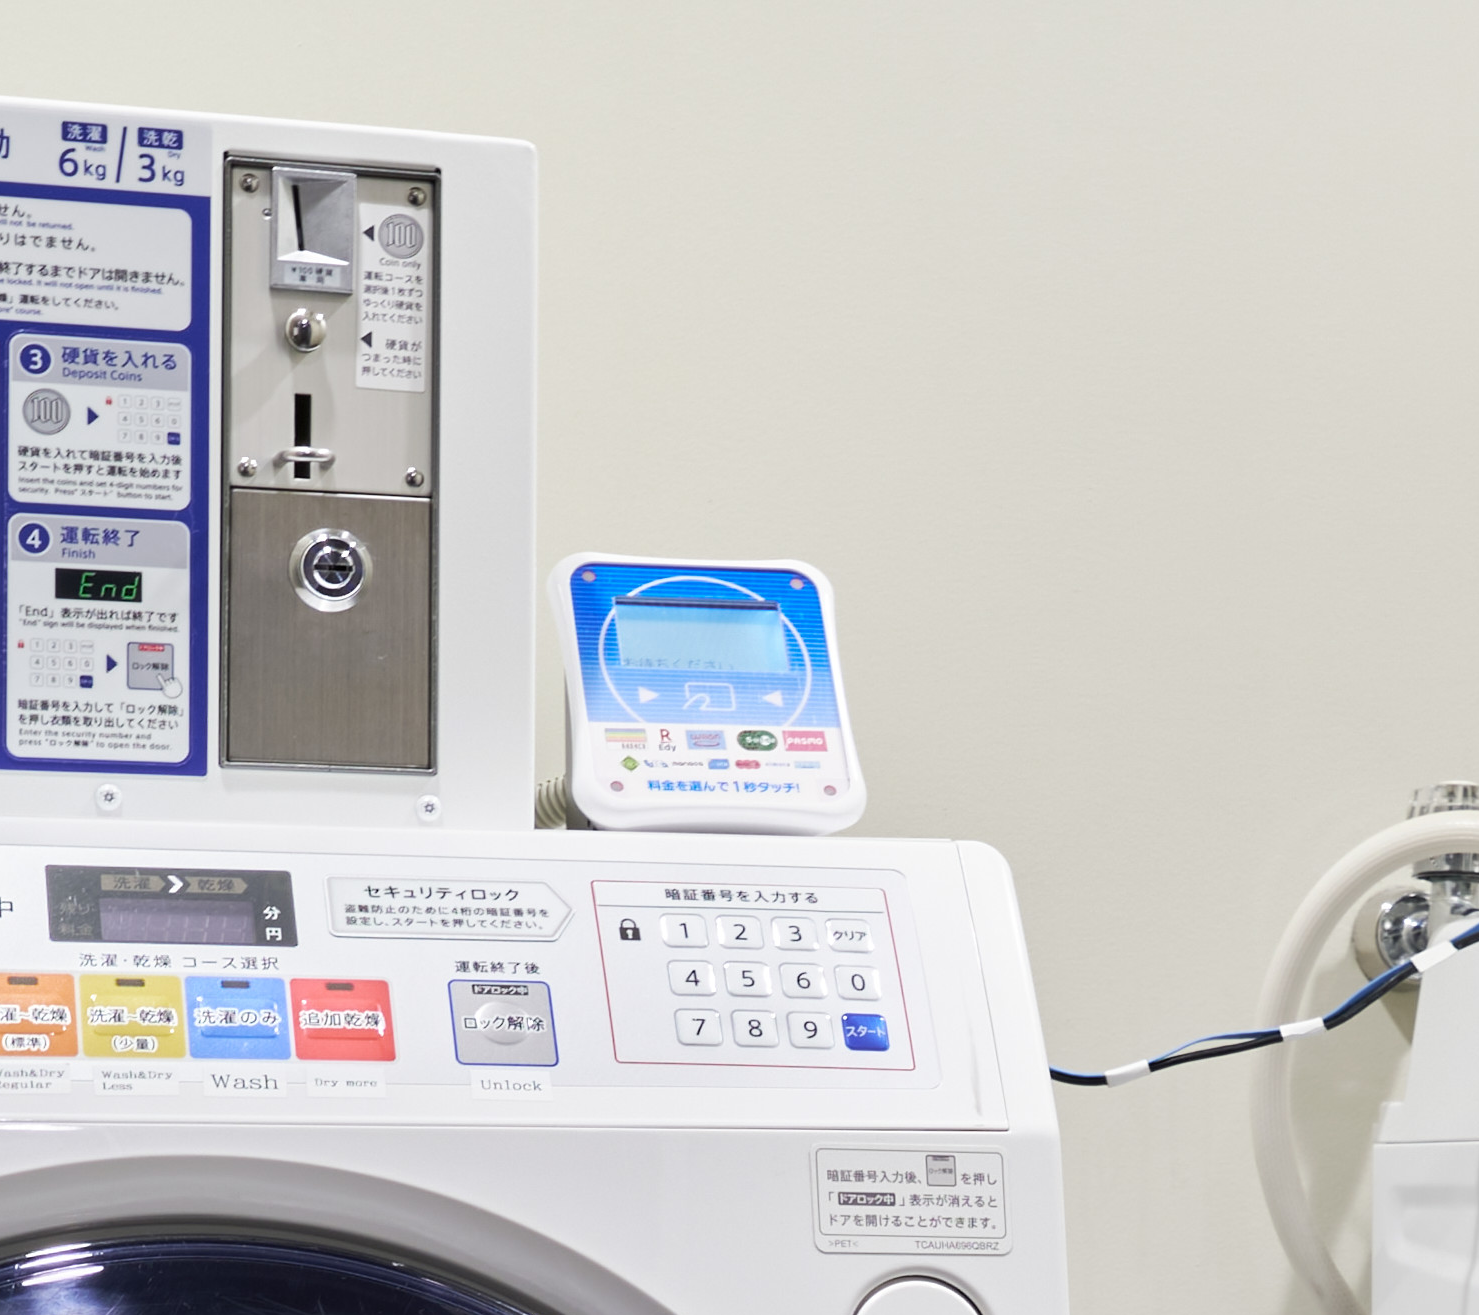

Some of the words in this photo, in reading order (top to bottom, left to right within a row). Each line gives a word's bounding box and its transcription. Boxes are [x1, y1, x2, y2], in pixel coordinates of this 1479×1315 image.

[66, 124, 104, 142] 洗濯
[141, 130, 181, 148] 洗乾
[362, 311, 424, 325] 入れてください
[385, 338, 421, 353] 硬貨が
[62, 347, 177, 370] 硬貨を入れる
[62, 369, 106, 380] Deposit
[110, 370, 142, 381] Coins
[361, 366, 423, 379] 押してください
[61, 527, 140, 547] 運転終了
[62, 550, 95, 559] Finish
[79, 572, 139, 599] End
[363, 885, 521, 902] セキュリティロック
[664, 888, 819, 904] 暗証番号を入力する
[680, 922, 689, 940] 1
[735, 924, 748, 941] 2
[789, 925, 802, 942] 3
[833, 928, 867, 942] クリア
[182, 955, 279, 971] コース選択
[685, 969, 700, 987] 4
[742, 969, 754, 988] 5
[797, 972, 811, 989] 6
[851, 974, 865, 991] 0
[196, 1009, 279, 1027] 洗濯のみ
[301, 1009, 383, 1028] 追加乾燥
[462, 1015, 546, 1032] ロック解除
[692, 1018, 706, 1037] 7
[748, 1019, 763, 1038] 8
[803, 1020, 817, 1038] 9
[846, 1024, 885, 1038] スタート
[211, 1072, 278, 1091] Wash
[480, 1078, 542, 1093] Unlock
[829, 1214, 996, 1230] ドアを開けることができます。
